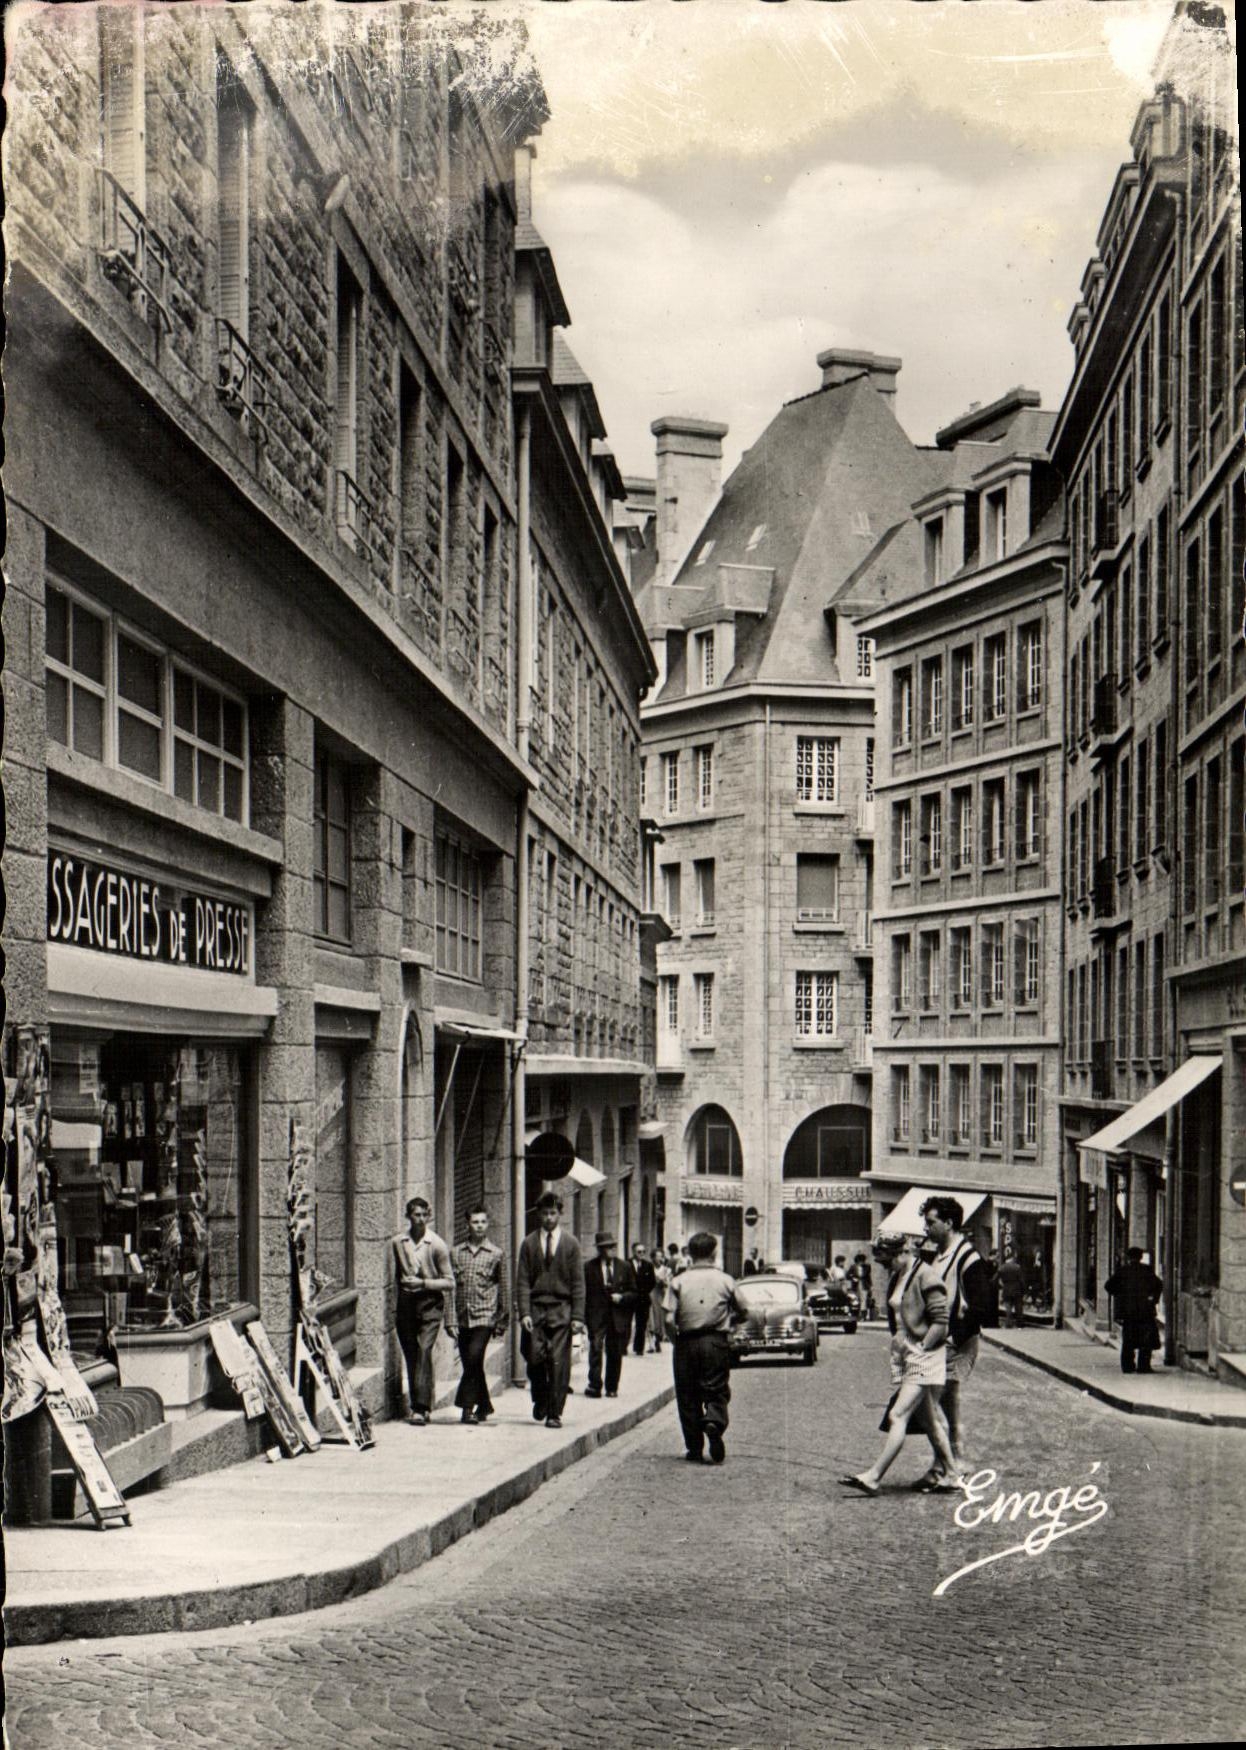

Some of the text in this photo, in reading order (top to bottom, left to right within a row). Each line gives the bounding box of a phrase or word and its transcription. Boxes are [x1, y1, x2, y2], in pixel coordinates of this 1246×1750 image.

[50, 857, 250, 972] SSAGERIES DE PRESSE
